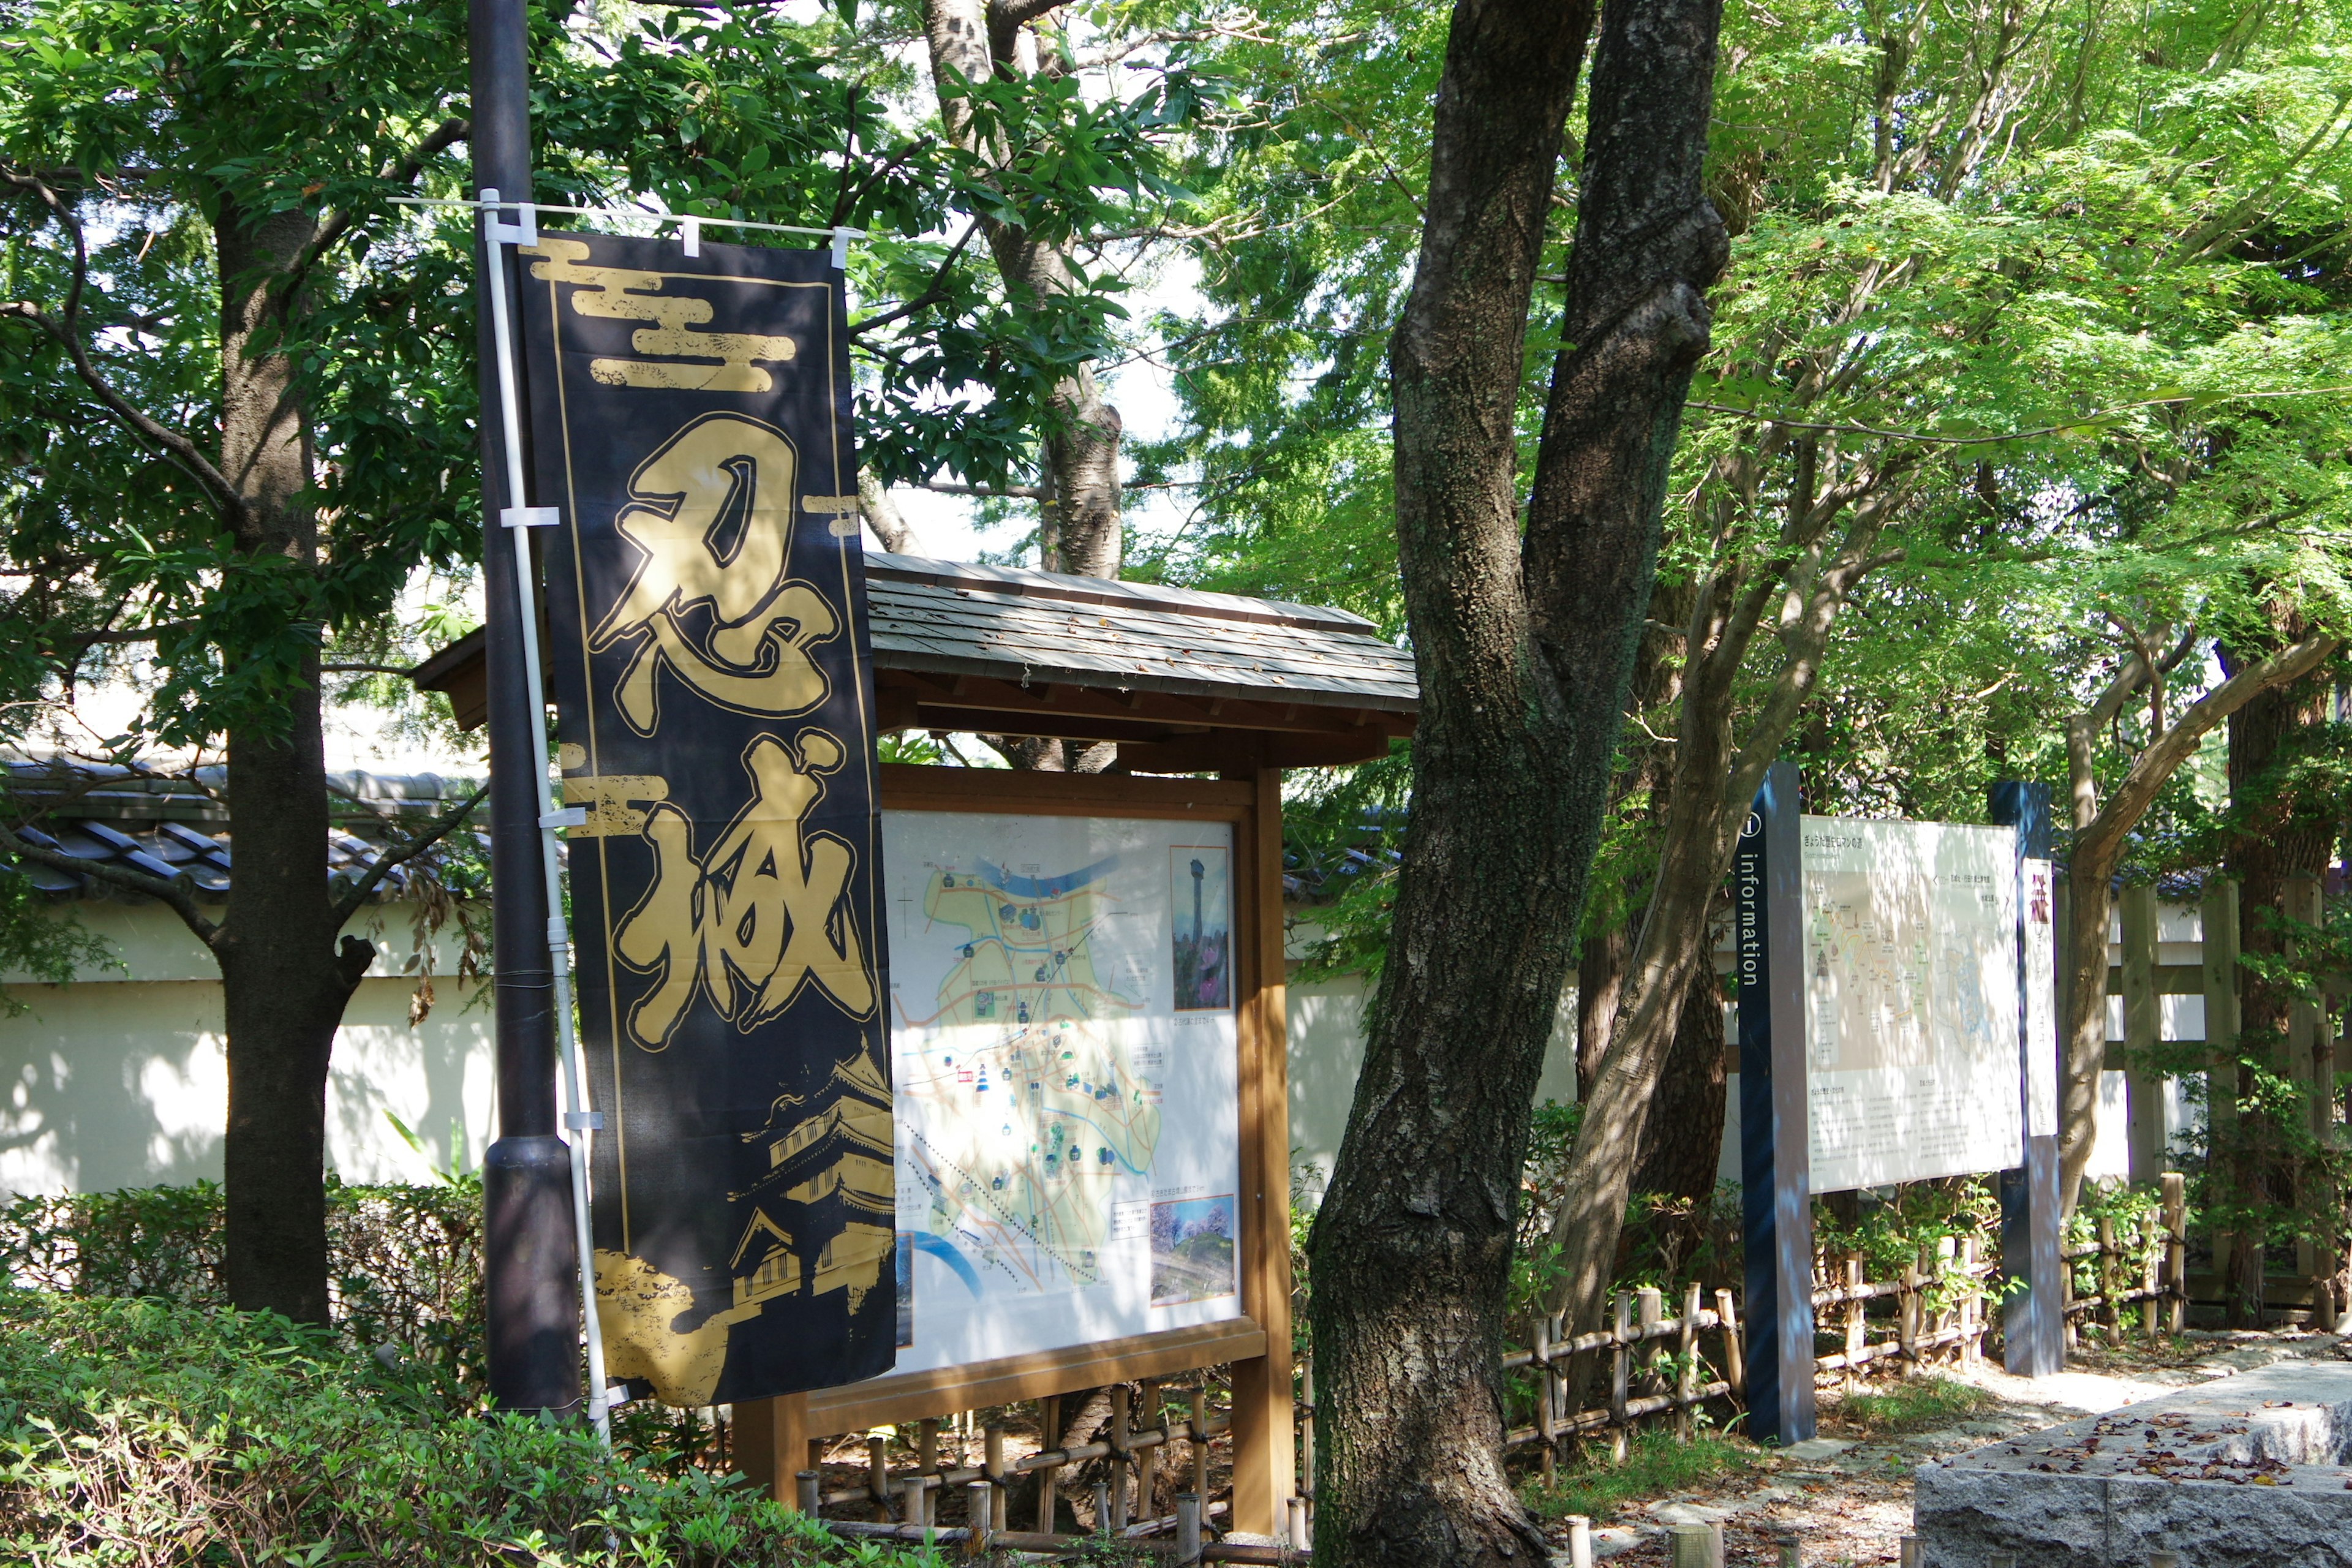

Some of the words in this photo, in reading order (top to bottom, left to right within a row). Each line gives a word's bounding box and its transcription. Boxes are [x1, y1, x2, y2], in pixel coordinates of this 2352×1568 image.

[587, 409, 878, 1055] 忍城
[1804, 834, 1863, 849] ぎょうだ歴史ロマンの道
[1741, 854, 1761, 986] information
